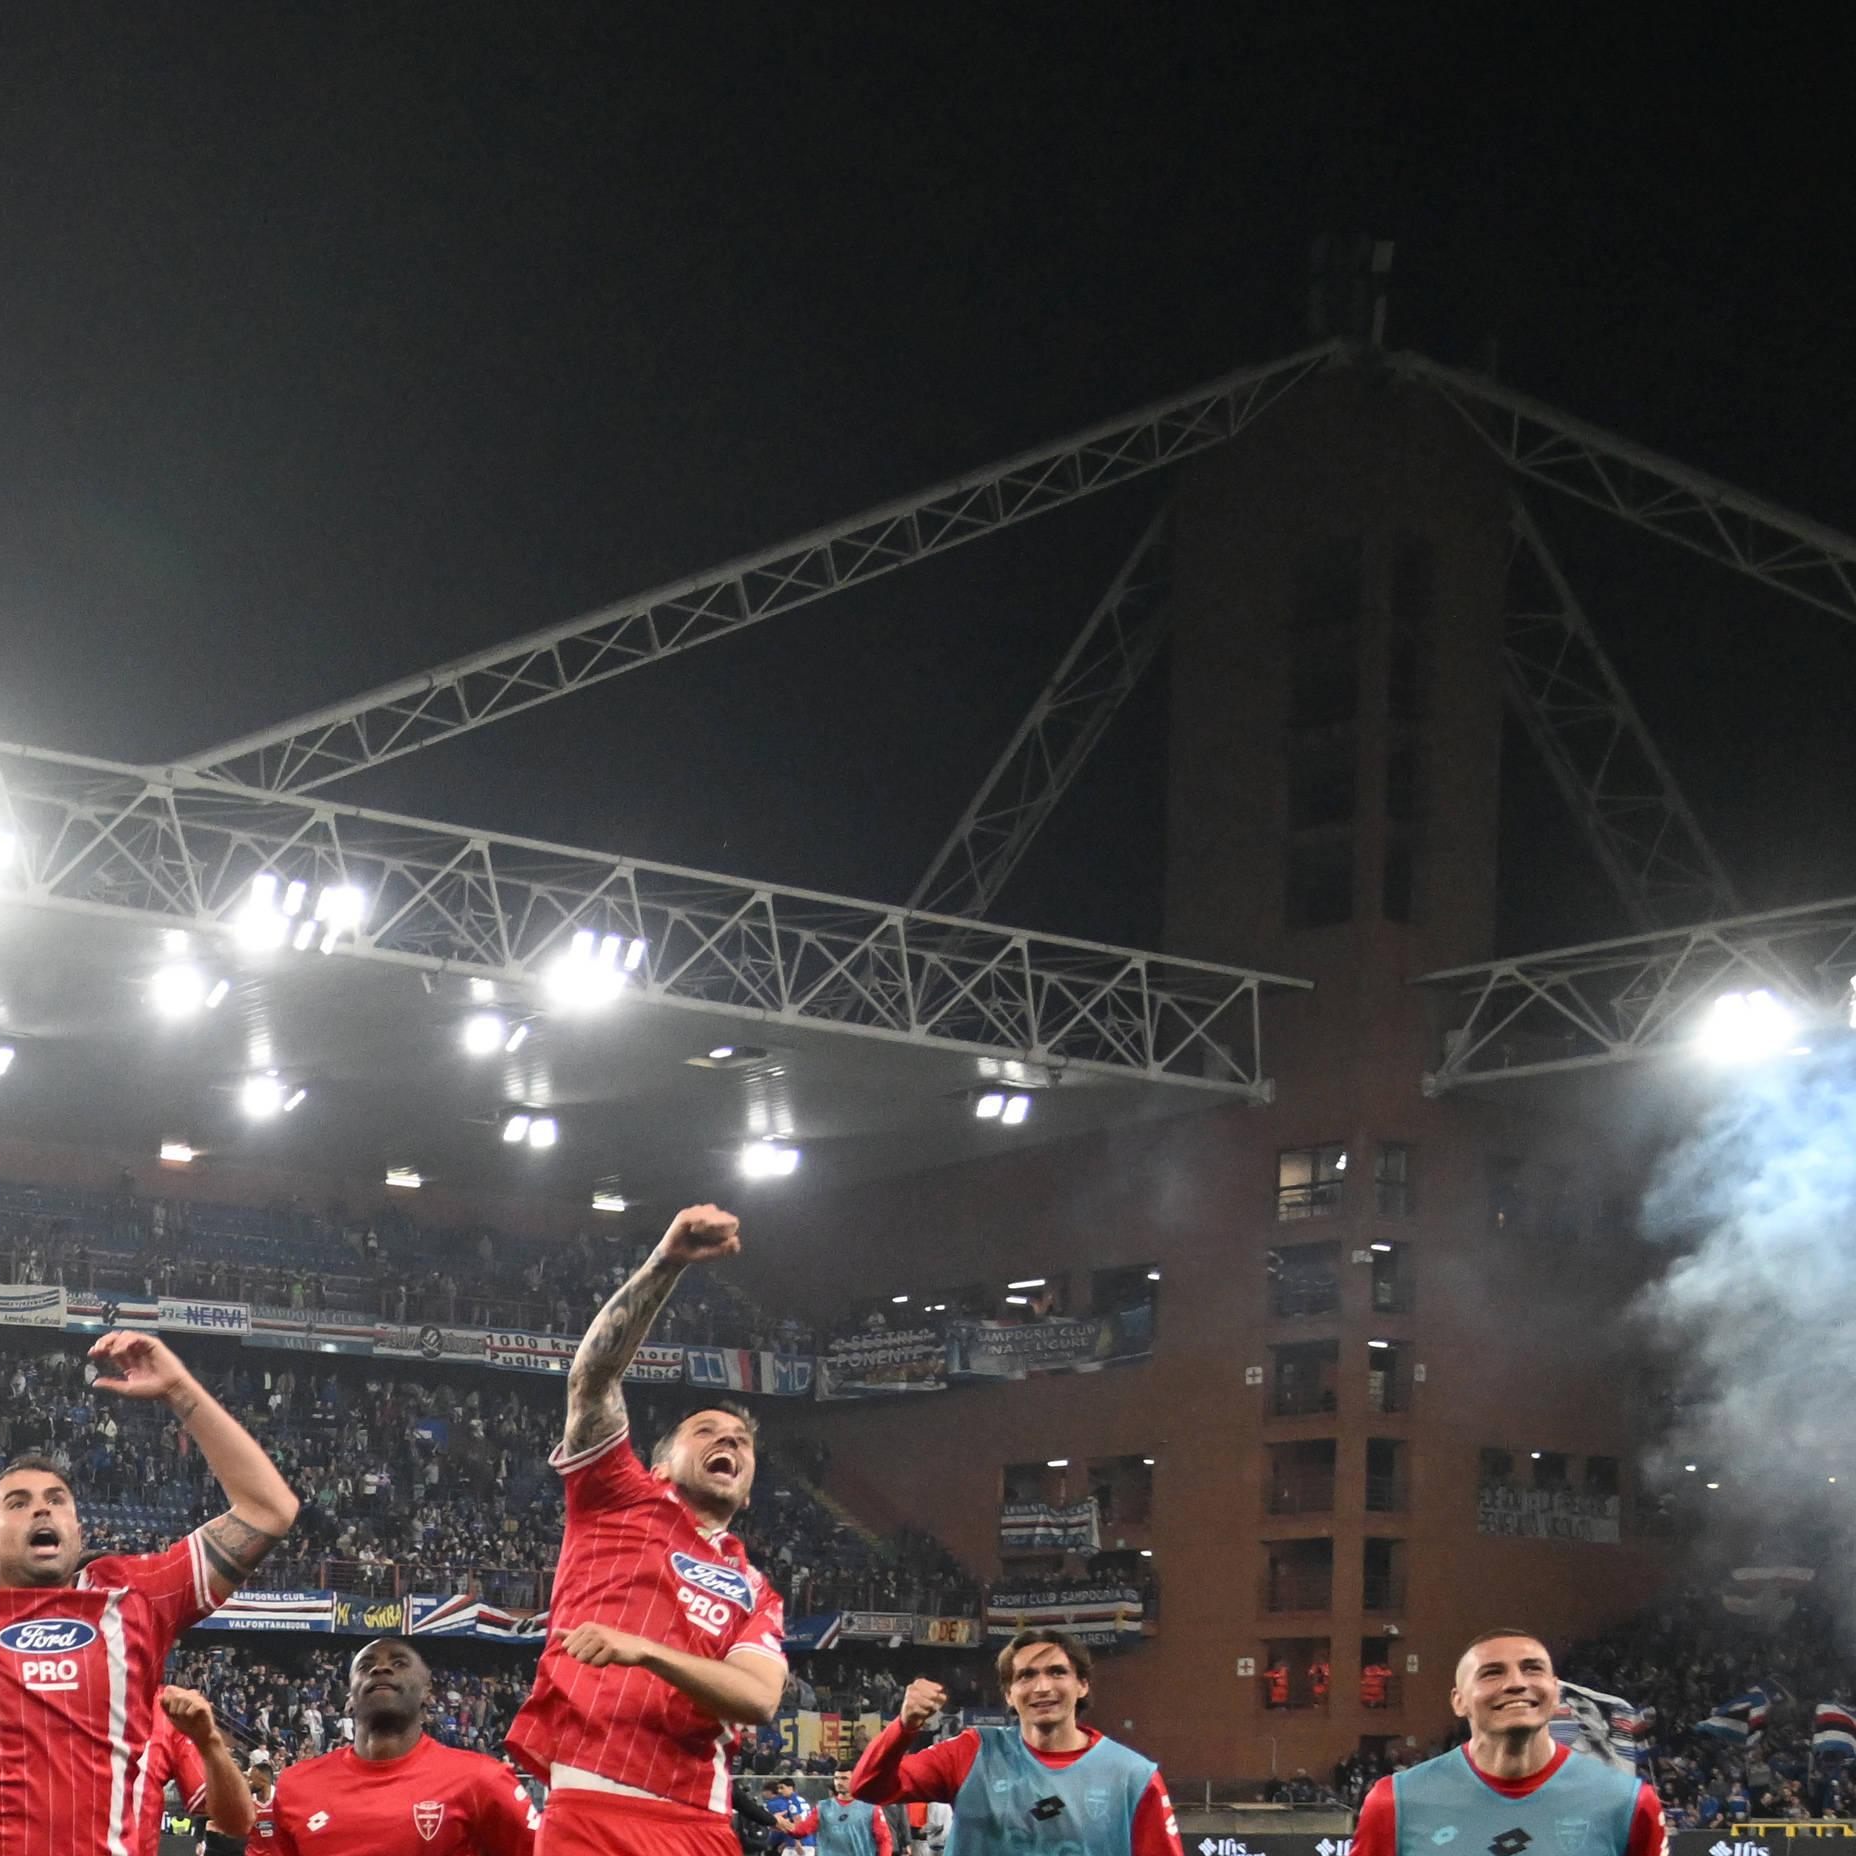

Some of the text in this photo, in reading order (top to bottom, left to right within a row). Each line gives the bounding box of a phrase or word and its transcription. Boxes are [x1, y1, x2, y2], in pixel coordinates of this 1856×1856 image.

[187, 1304, 246, 1329] NERVI
[486, 1333, 538, 1349] 1000
[683, 1563, 747, 1599] Ford
[283, 1592, 305, 1601] CLUB
[678, 1586, 731, 1625] PRO
[15, 1624, 76, 1650] Ford
[22, 1660, 79, 1681] PRO
[1217, 1838, 1248, 1856] Ifis
